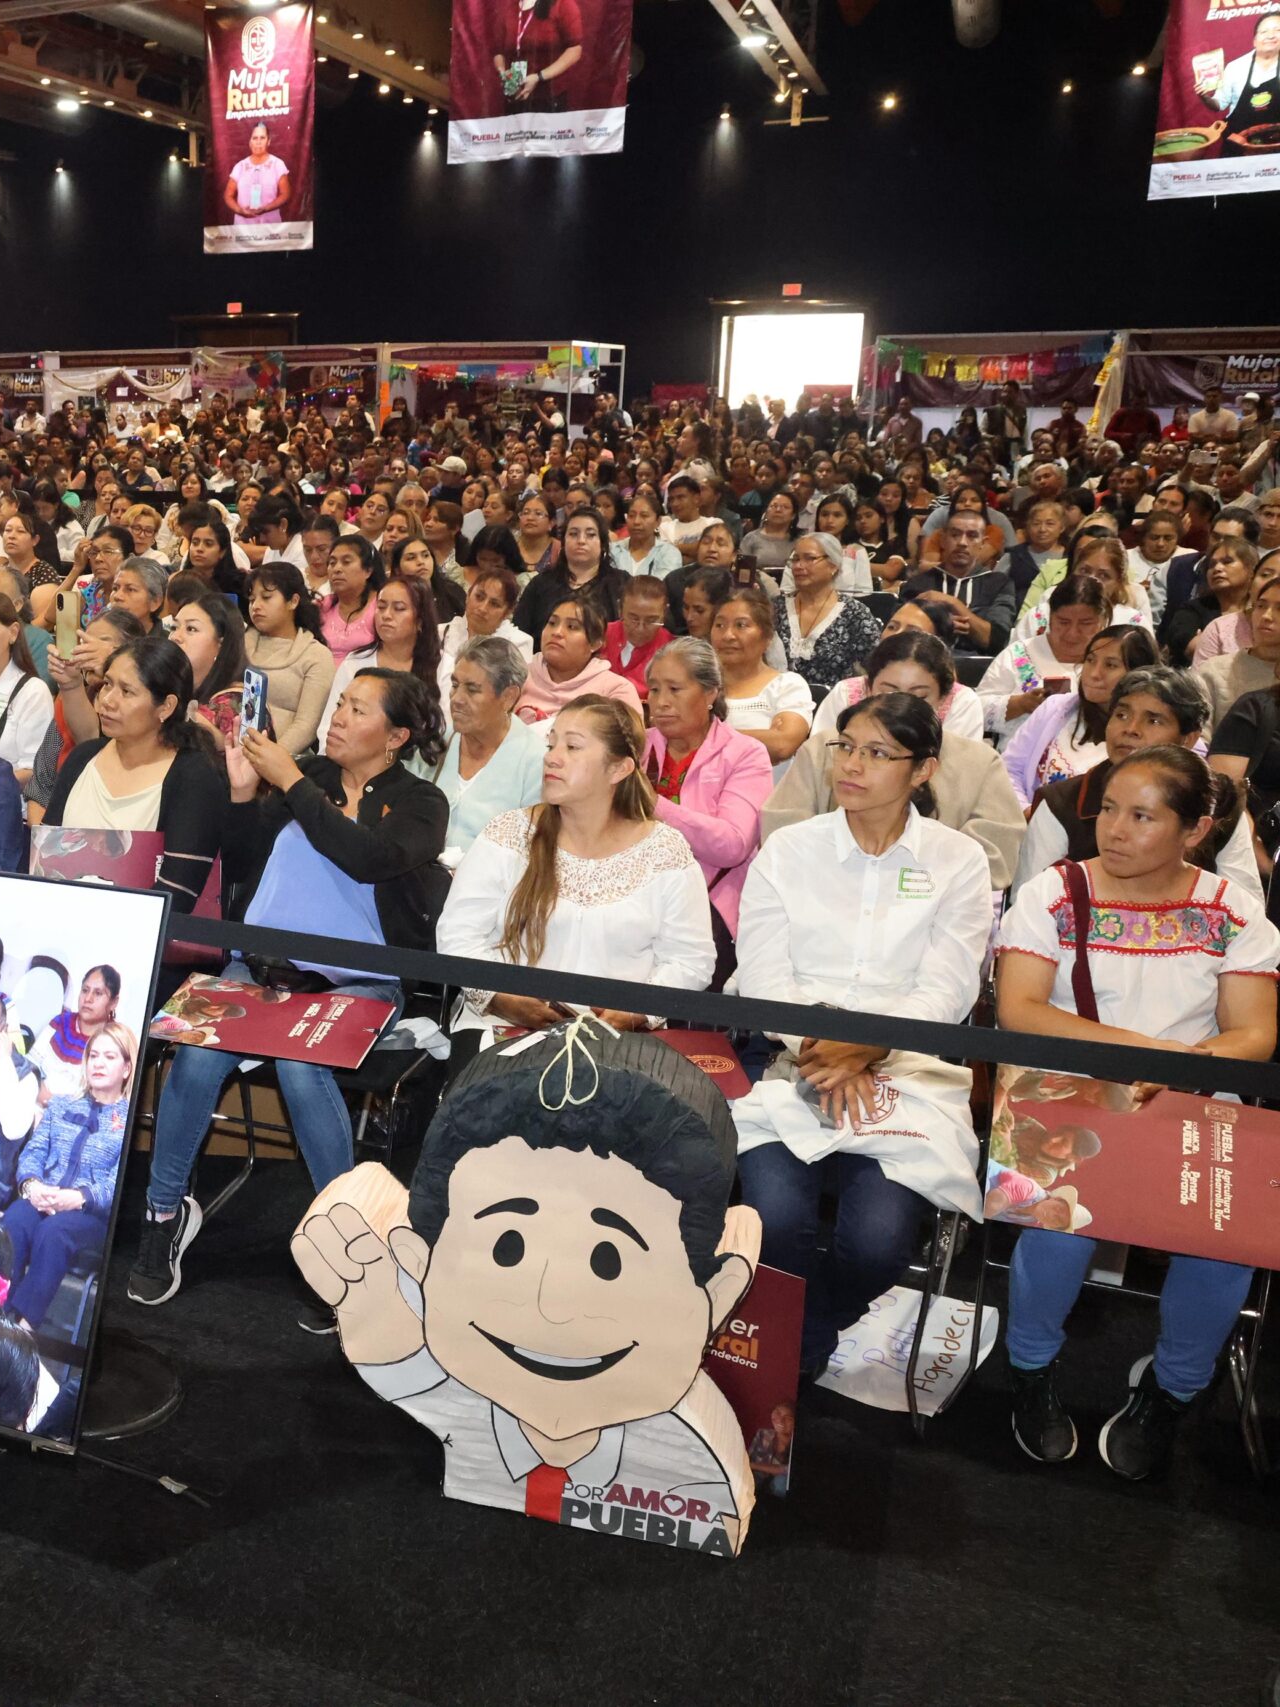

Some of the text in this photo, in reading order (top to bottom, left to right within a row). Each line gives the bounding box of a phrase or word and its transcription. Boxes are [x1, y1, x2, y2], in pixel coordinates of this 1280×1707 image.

[1206, 1, 1280, 20] Emprende
[228, 66, 290, 91] Mujer
[227, 83, 290, 111] Rural
[472, 133, 500, 142] PUEBLA
[1173, 173, 1201, 181] PUEBLA
[1226, 355, 1280, 372] Mujer
[1182, 1120, 1193, 1155] PUEBLA
[1221, 1123, 1234, 1163] PUEBLA
[1189, 1171, 1200, 1203] Pensar
[1214, 1167, 1224, 1231] Desarrollo Rural
[1222, 1169, 1233, 1213] Agricultura
[563, 1480, 604, 1501] POR
[603, 1484, 711, 1523] AMOR
[560, 1497, 734, 1558] PUEBLA
